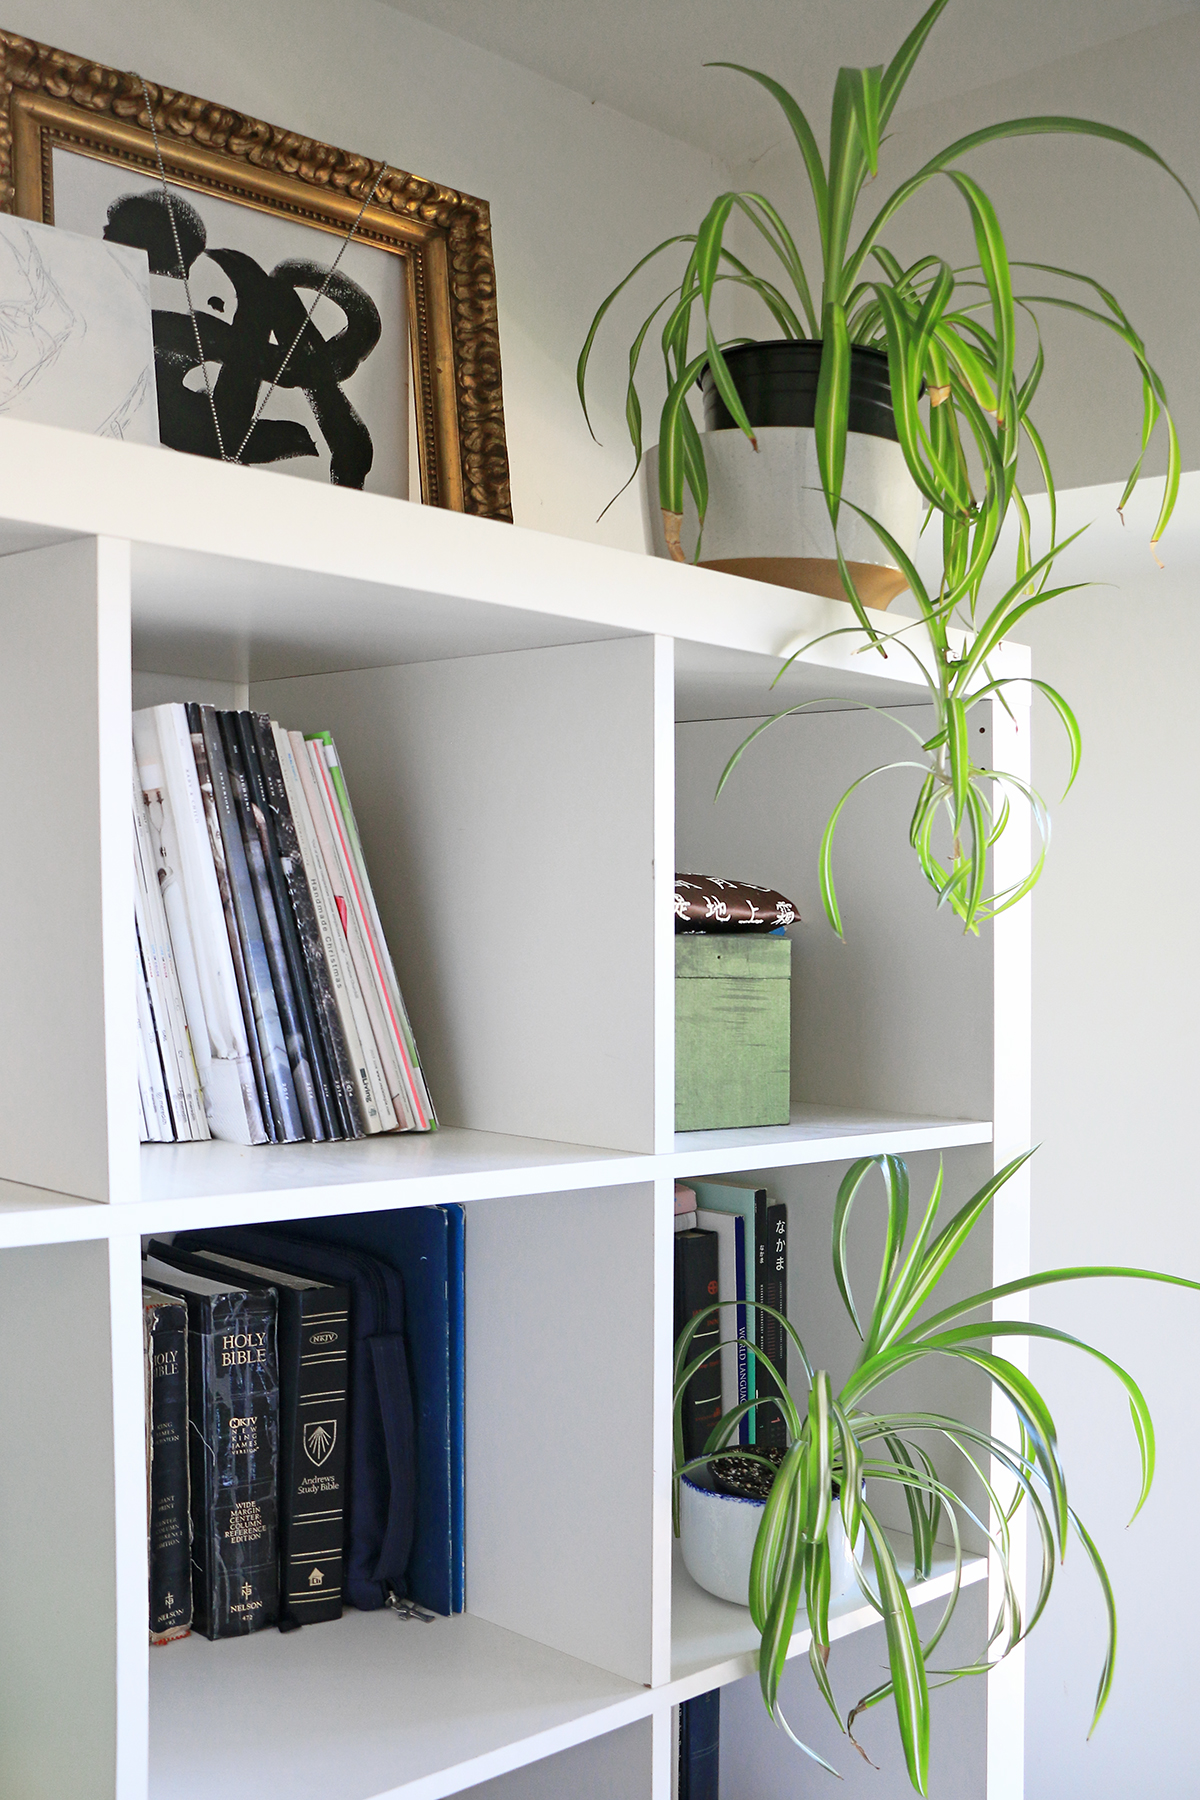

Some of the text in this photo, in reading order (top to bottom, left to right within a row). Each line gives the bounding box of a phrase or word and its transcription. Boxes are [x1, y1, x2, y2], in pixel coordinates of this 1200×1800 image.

[219, 772, 230, 814] INTERIORS
[240, 774, 250, 812] LIGHTING
[311, 879, 342, 989] Handmade Christmas
[362, 1078, 372, 1103] Living
[776, 1220, 786, 1270] なかま
[222, 1332, 266, 1350] HOLY
[312, 1334, 334, 1342] NKJV
[222, 1349, 266, 1366] BIBLE
[230, 1416, 258, 1428] NKJV
[232, 1426, 257, 1434] NEW
[232, 1434, 257, 1442] KING
[232, 1440, 257, 1450] JAMES
[302, 1476, 335, 1485] Andrews
[298, 1482, 340, 1494] Study Bible
[236, 1501, 256, 1509] WIDE
[231, 1507, 260, 1516] MARGIN
[230, 1520, 262, 1530] COLUMN
[225, 1525, 266, 1538] REFERENCE
[231, 1533, 261, 1544] EDITION
[231, 1601, 263, 1613] NELSON
[158, 1609, 184, 1622] NELSON
